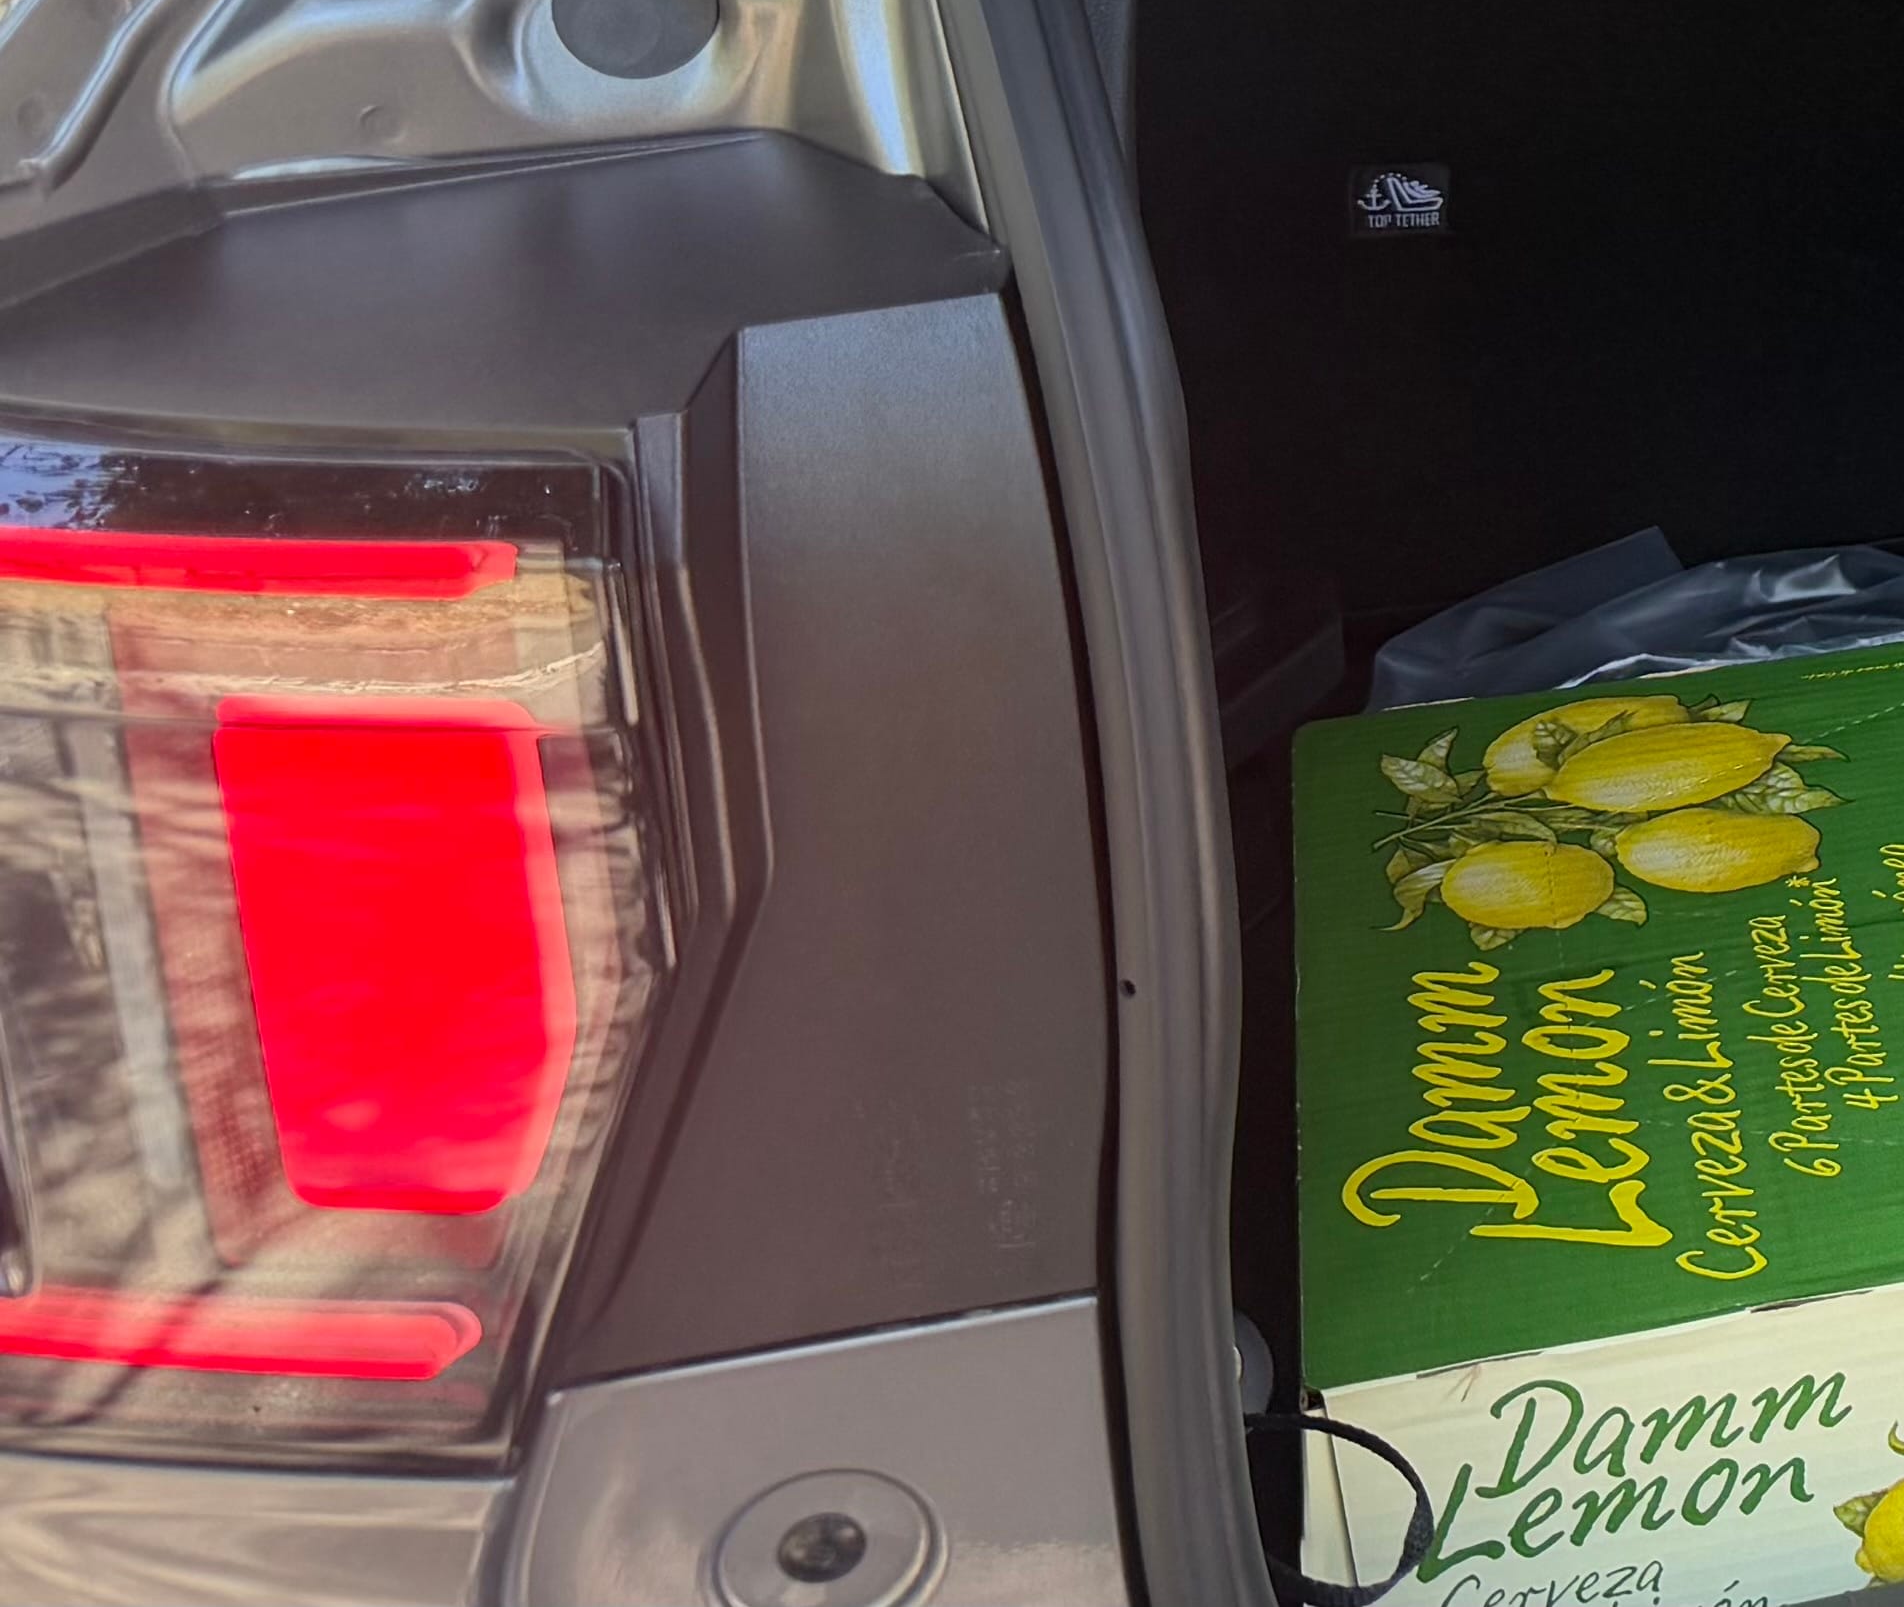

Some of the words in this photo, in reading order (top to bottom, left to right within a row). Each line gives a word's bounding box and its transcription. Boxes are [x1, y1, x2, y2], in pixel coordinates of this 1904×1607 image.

[1368, 214, 1392, 229] TOP
[1395, 212, 1440, 228] TETHER
[1638, 950, 1734, 1070] Limón
[1742, 914, 1806, 1019] Cerveza
[1800, 962, 1873, 996] de
[1746, 1019, 1819, 1055] de
[1823, 998, 1896, 1086] Partes
[1342, 960, 1540, 1227] Damm
[1469, 968, 1673, 1247] Lemon
[1768, 1056, 1841, 1153] Partes
[1842, 1088, 1899, 1110] 4
[1675, 1109, 1768, 1280] Cerveza
[1783, 1157, 1842, 1178] 6
[1475, 1364, 1853, 1499] Damm
[1416, 1456, 1815, 1584] Lemon
